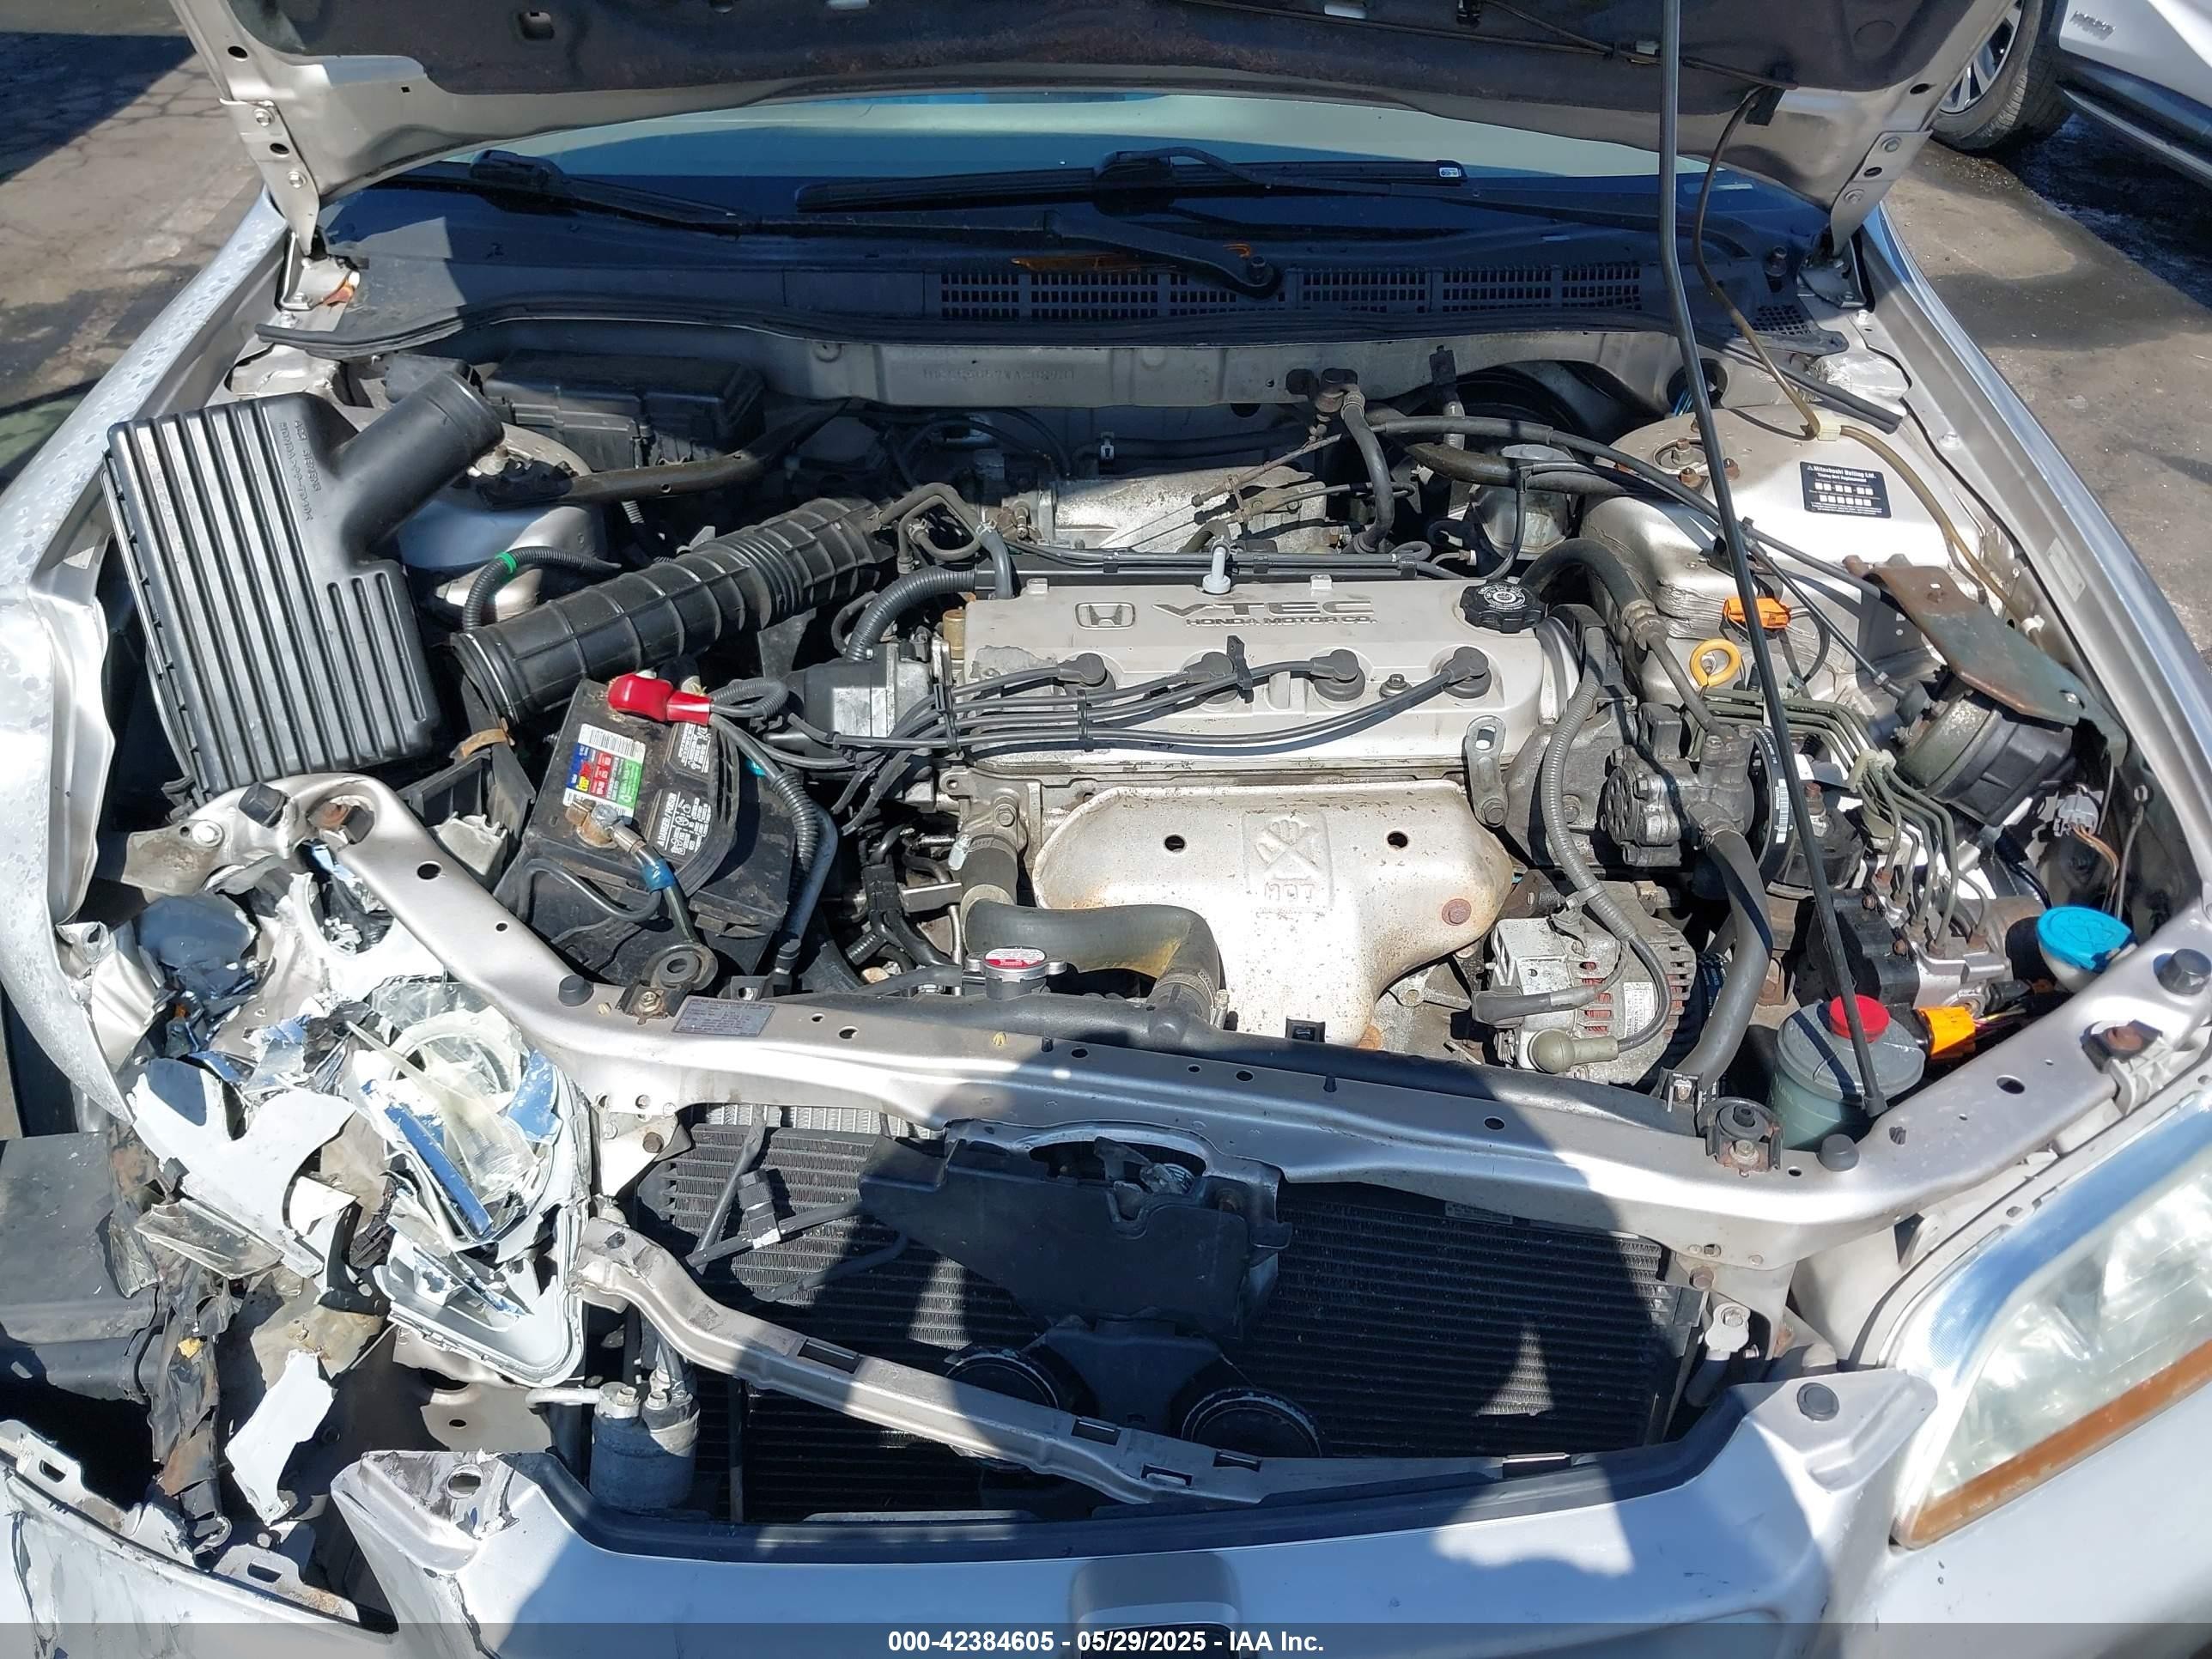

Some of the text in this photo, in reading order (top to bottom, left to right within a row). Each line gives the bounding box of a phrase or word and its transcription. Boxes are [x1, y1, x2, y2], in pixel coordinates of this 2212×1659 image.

[1152, 601, 1375, 617] VTEC
[1186, 615, 1378, 627] HONDA MOTOR CO.
[1264, 882, 1316, 905] HOT
